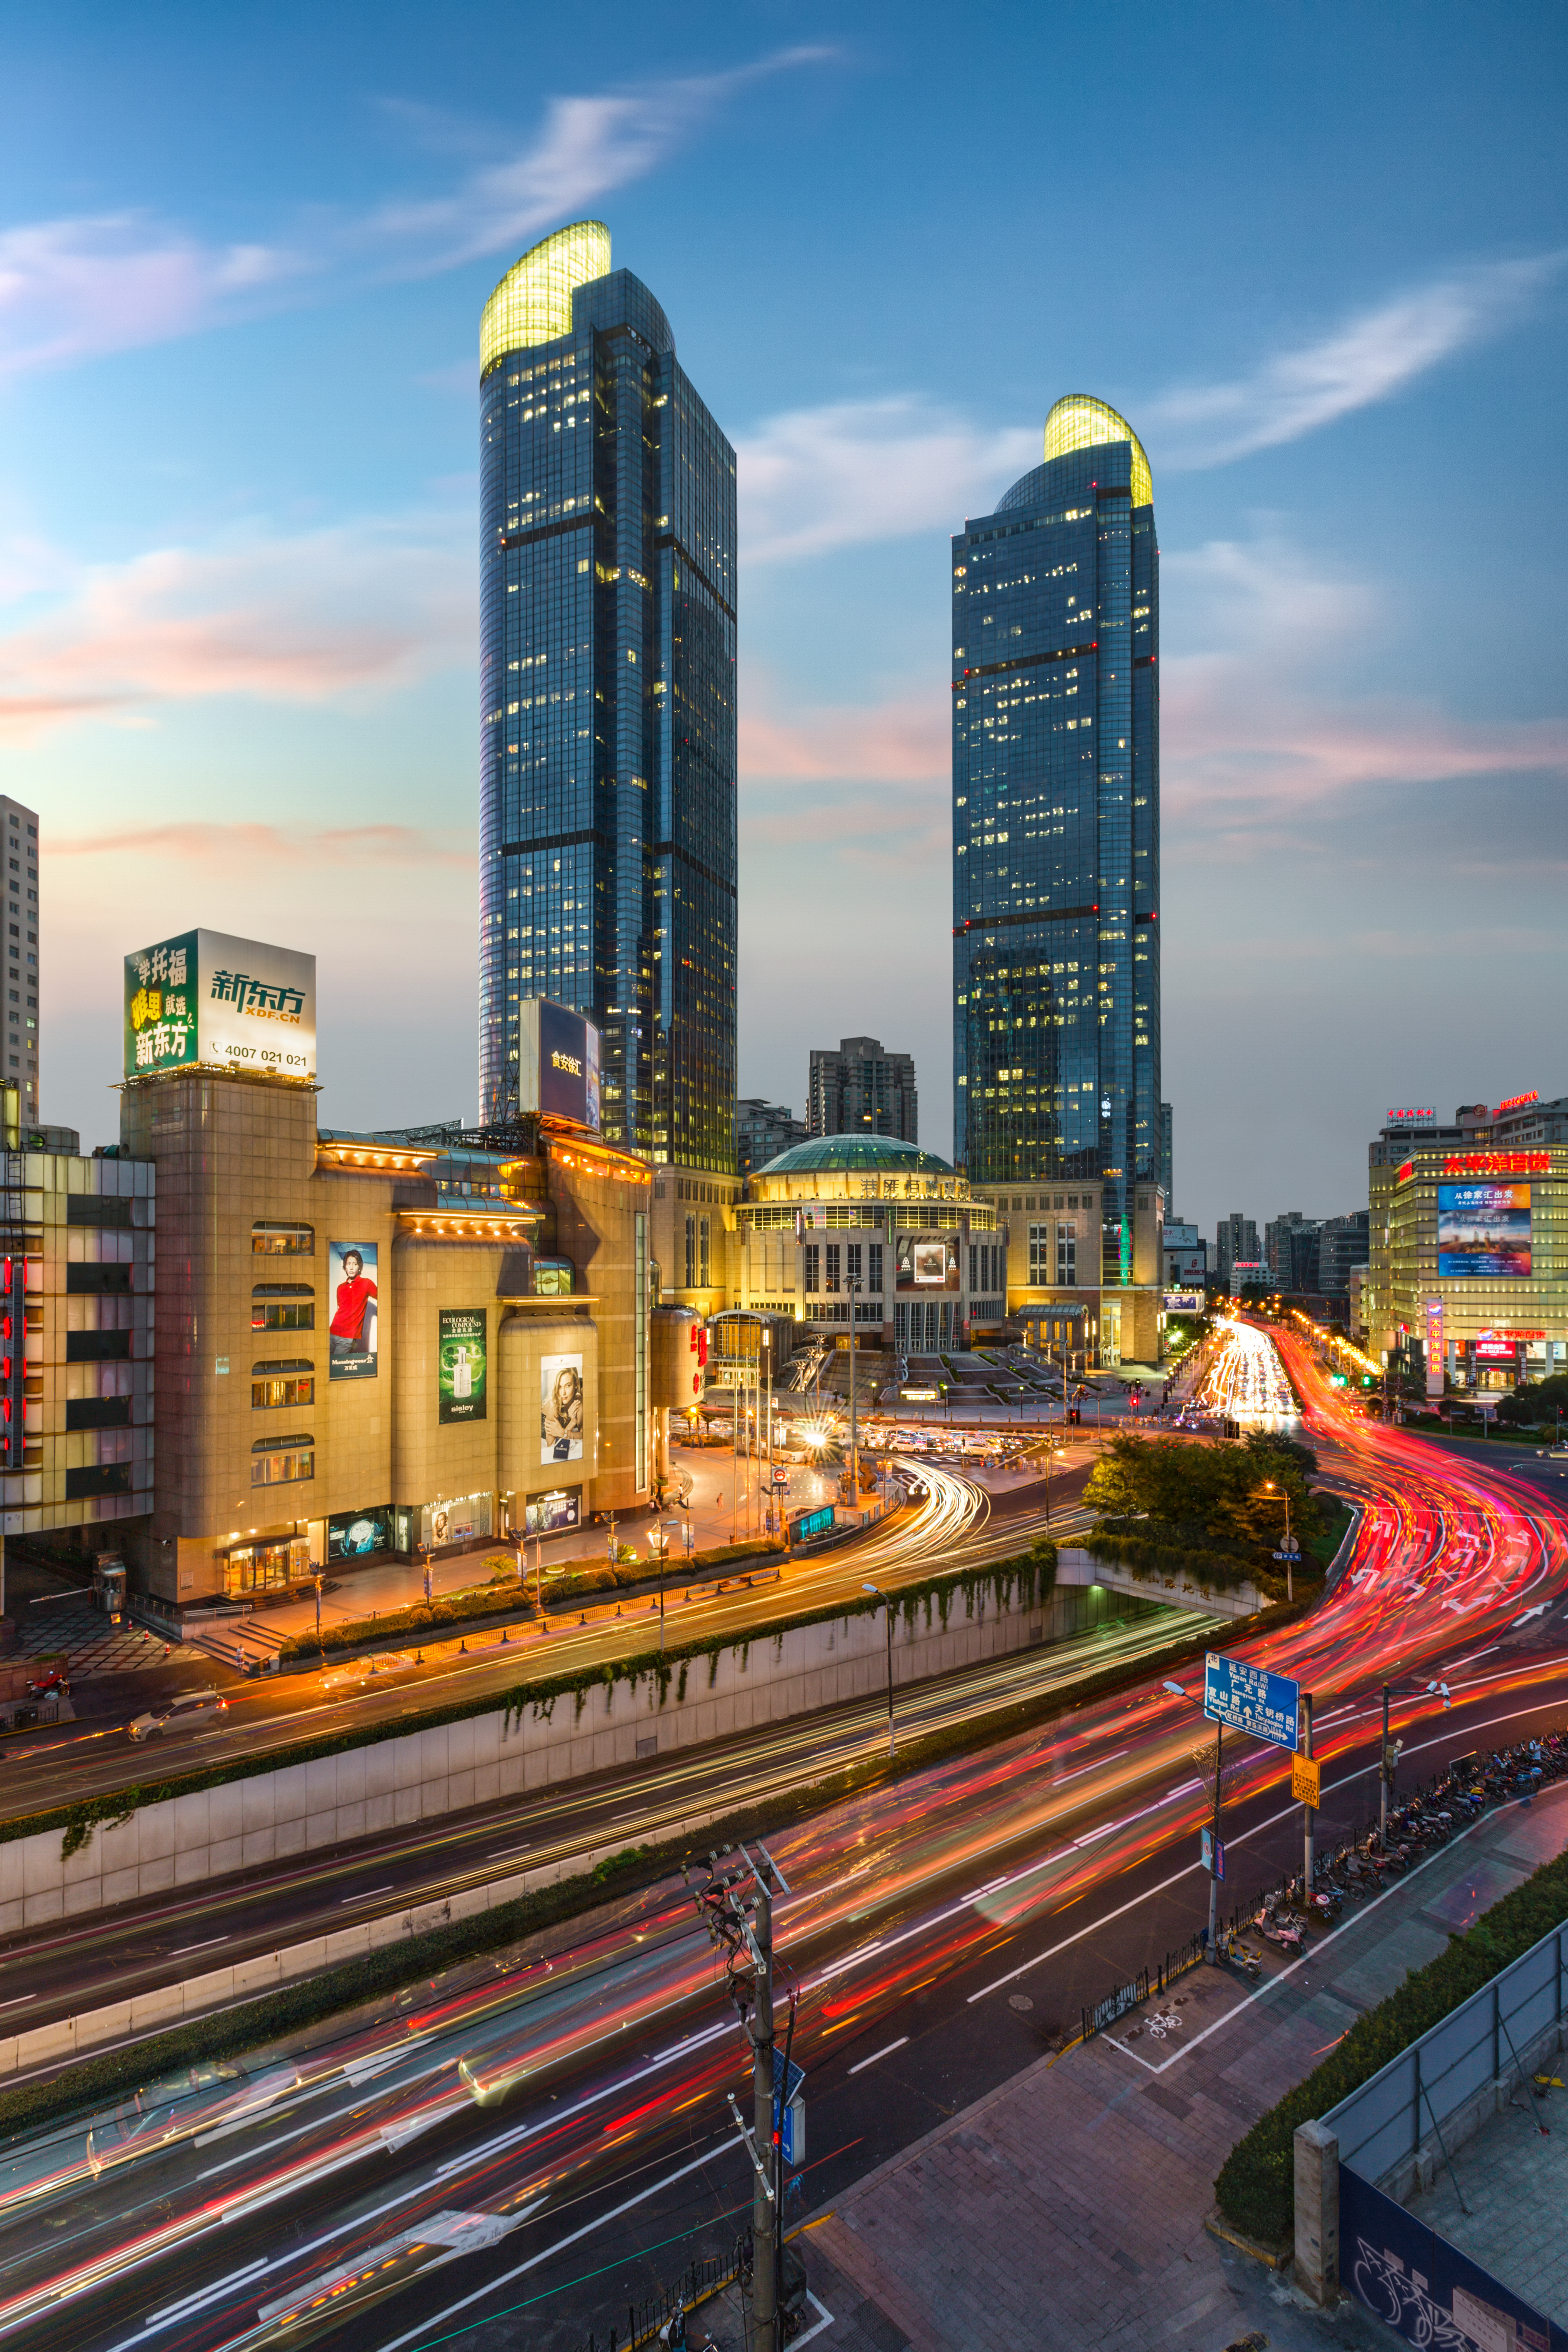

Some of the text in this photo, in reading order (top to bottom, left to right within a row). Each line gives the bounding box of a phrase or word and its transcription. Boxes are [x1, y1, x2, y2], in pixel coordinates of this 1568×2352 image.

[138, 947, 187, 987] 学托福
[211, 970, 305, 1013] 新东方
[131, 987, 162, 1030] 雅思
[165, 994, 186, 1017] 就选
[245, 1007, 300, 1024] XDF.CN
[136, 1021, 188, 1065] 新东方
[225, 1045, 307, 1067] 4007 021 021
[552, 1051, 581, 1076] 食安徐汇
[1444, 1154, 1551, 1173] 太平洋百货
[1454, 1190, 1513, 1199] 从徐家汇出发
[1493, 1330, 1547, 1340] 太平洋百货
[1431, 1319, 1441, 1372] 太平洋百货
[1211, 1654, 1217, 1663] 北
[1229, 1662, 1268, 1684] 延安西路
[1208, 1686, 1240, 1706] 宜山路
[1231, 1679, 1267, 1699] 广元路
[1232, 1688, 1256, 1701] Guangyuan
[1208, 1695, 1228, 1708] Yishan
[1227, 1713, 1243, 1724] 虹桥路
[1255, 1704, 1294, 1726] 天钥桥路
[1255, 1713, 1294, 1733] Tianyaoqiao Rd.
